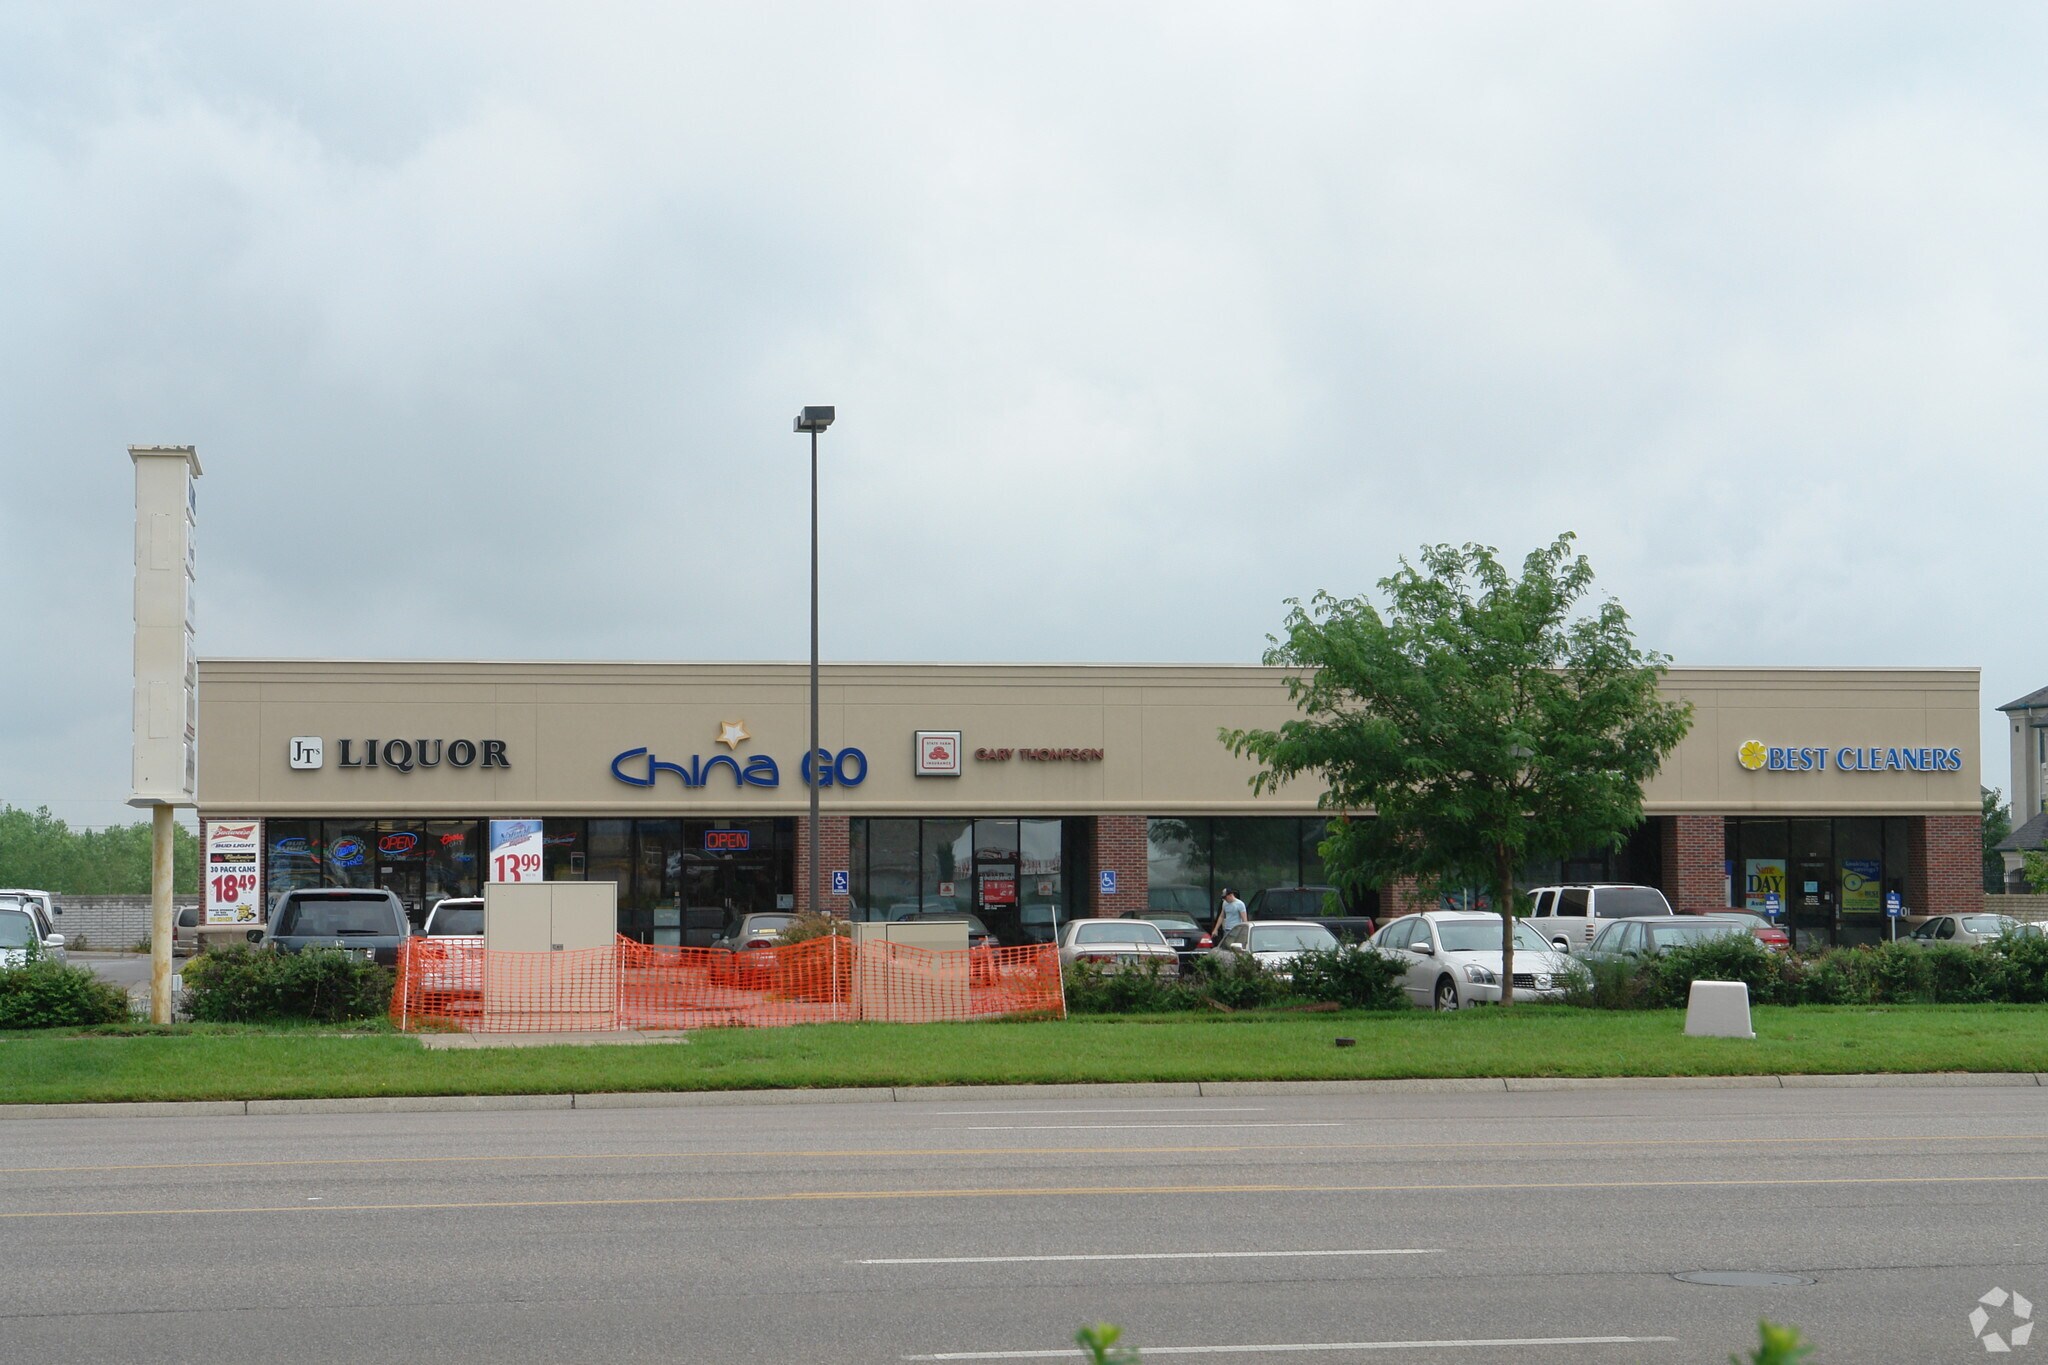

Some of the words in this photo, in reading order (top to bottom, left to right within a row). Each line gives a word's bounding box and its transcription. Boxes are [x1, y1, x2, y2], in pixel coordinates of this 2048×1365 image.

[338, 739, 511, 773] LIQUOR
[974, 748, 1014, 762] GARY
[1019, 748, 1104, 762] THOMPSON
[1767, 747, 1829, 771] BEST
[1835, 747, 1963, 771] CLEANERS
[610, 746, 780, 787] China
[801, 747, 868, 788] GO
[379, 836, 415, 849] OPEN
[707, 833, 747, 848] OPEN
[1748, 874, 1784, 892] DAY
